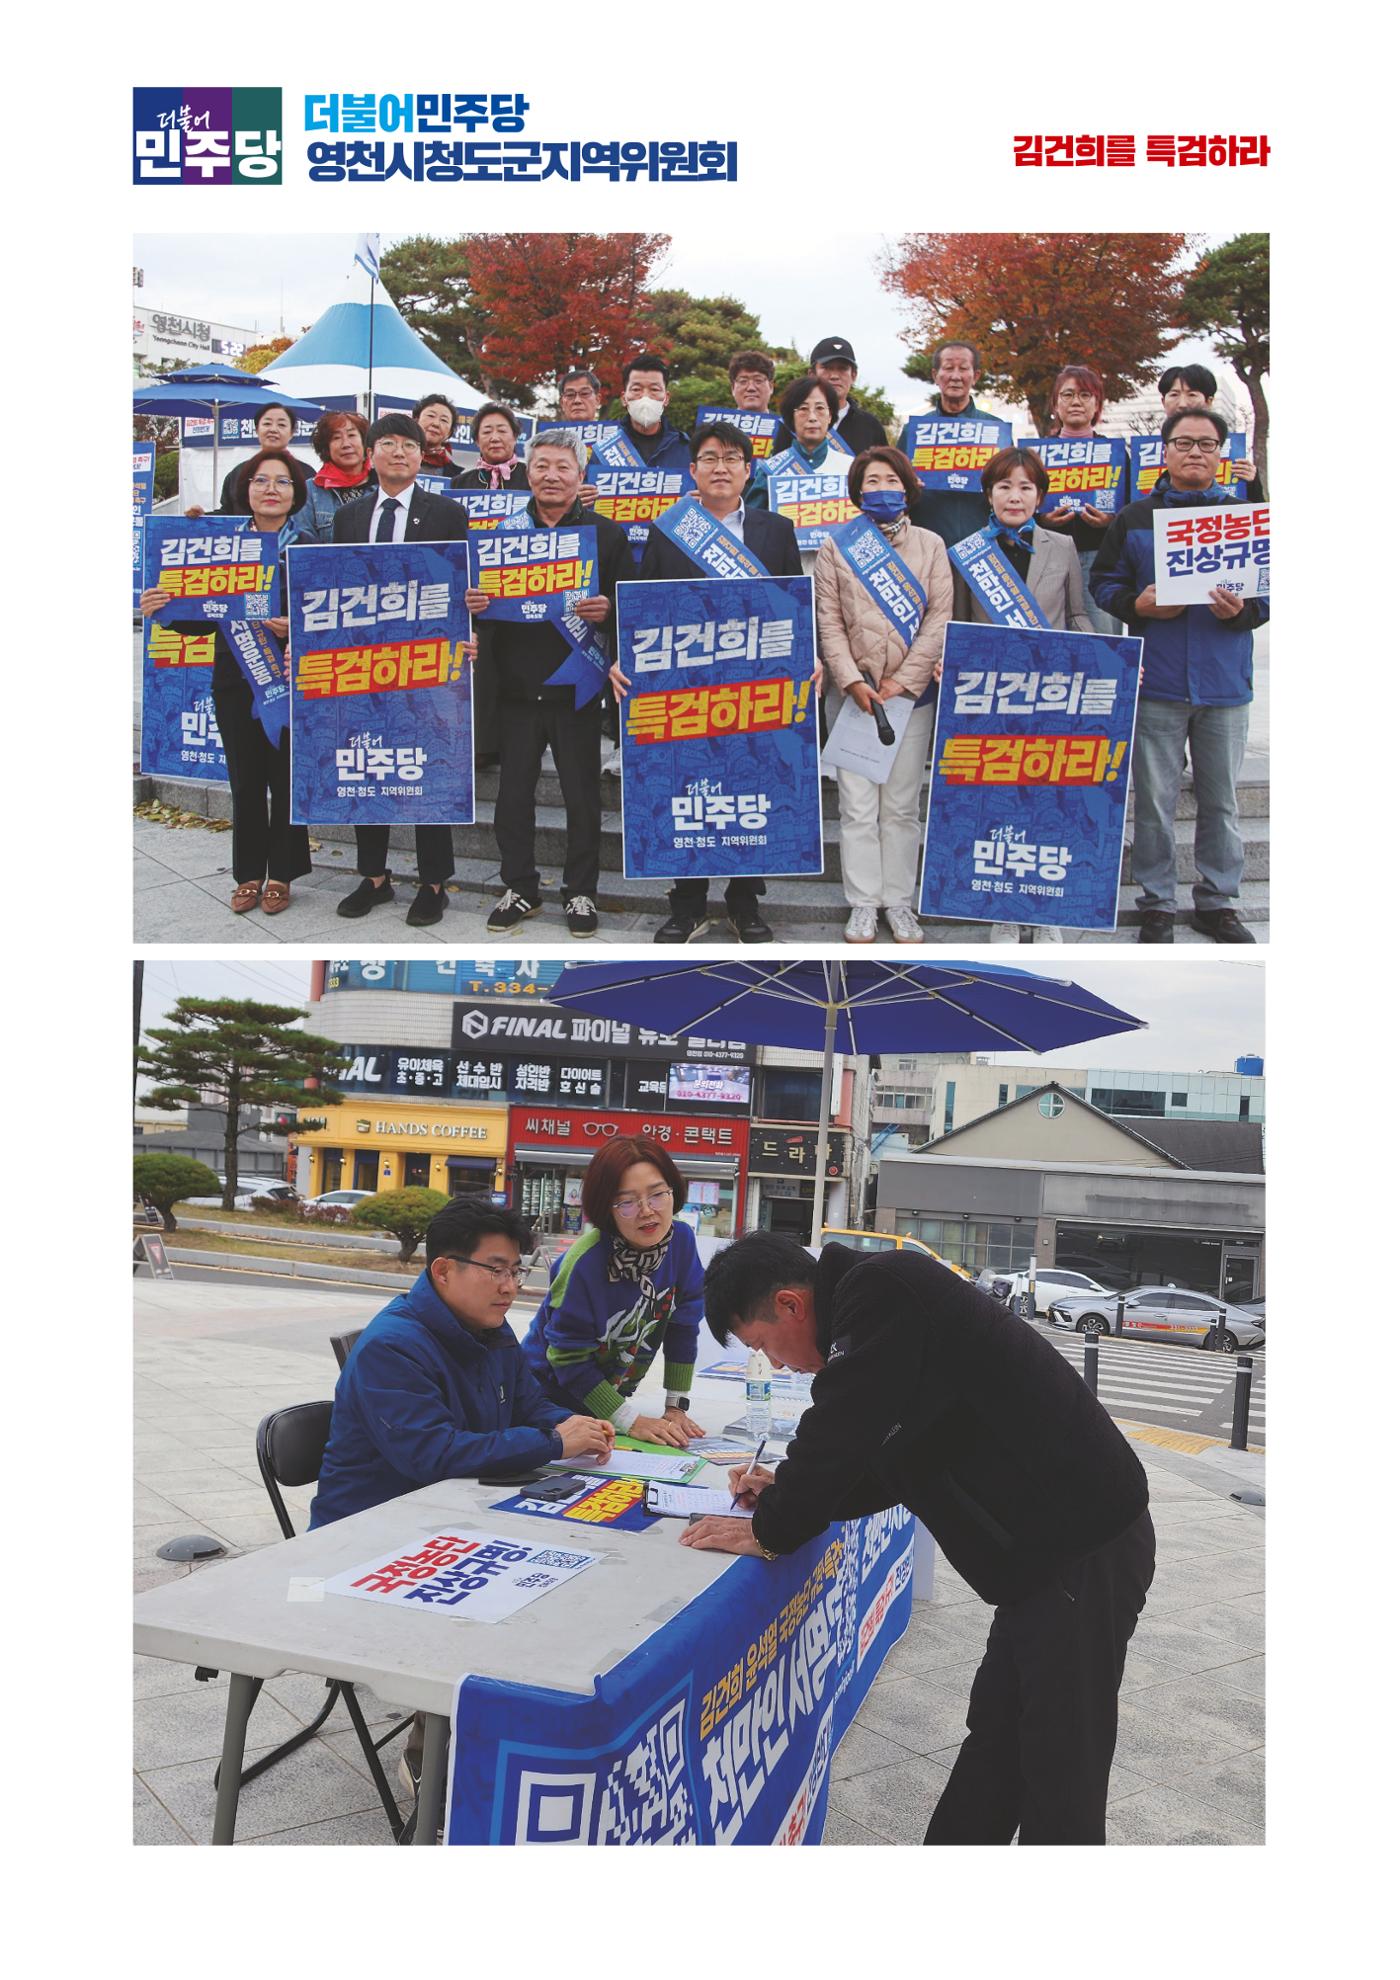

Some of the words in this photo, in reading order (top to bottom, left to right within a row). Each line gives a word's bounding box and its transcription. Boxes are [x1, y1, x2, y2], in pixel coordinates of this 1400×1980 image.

[152, 314, 211, 342] 영천시청
[915, 422, 1000, 445] 김건희를
[595, 471, 683, 496] 김건희를
[775, 475, 848, 504] 김건희
[160, 536, 262, 566] 김건희를
[477, 532, 580, 567] 김건희를
[157, 565, 275, 597] 특검하라!
[478, 560, 594, 597] 특검하라!
[301, 580, 451, 632] 김건희를
[632, 616, 794, 673] 김건희를
[295, 641, 465, 695] 특검하라!
[954, 671, 1117, 715] 김건희를
[626, 680, 813, 739] 특검하라!
[336, 747, 427, 782] 민주당
[938, 738, 1128, 782] 특검하라!
[380, 785, 423, 797] 지역위원회
[671, 794, 771, 831] 민주당
[721, 834, 767, 847] 지역위원회
[972, 840, 1073, 881] 민주당
[1018, 883, 1065, 897] 지역위원회
[491, 1016, 567, 1040] FINAL
[571, 1018, 630, 1044] 파이널
[515, 1063, 550, 1079] 성인반
[560, 1067, 602, 1082] 다이어트
[376, 1120, 428, 1136] HANDS
[431, 1124, 488, 1140] COFFEE
[525, 1117, 571, 1137] 씨채널
[350, 1535, 482, 1594] 국정농단
[403, 1539, 533, 1606] 진상규명!
[700, 1657, 744, 1742] 김건희
